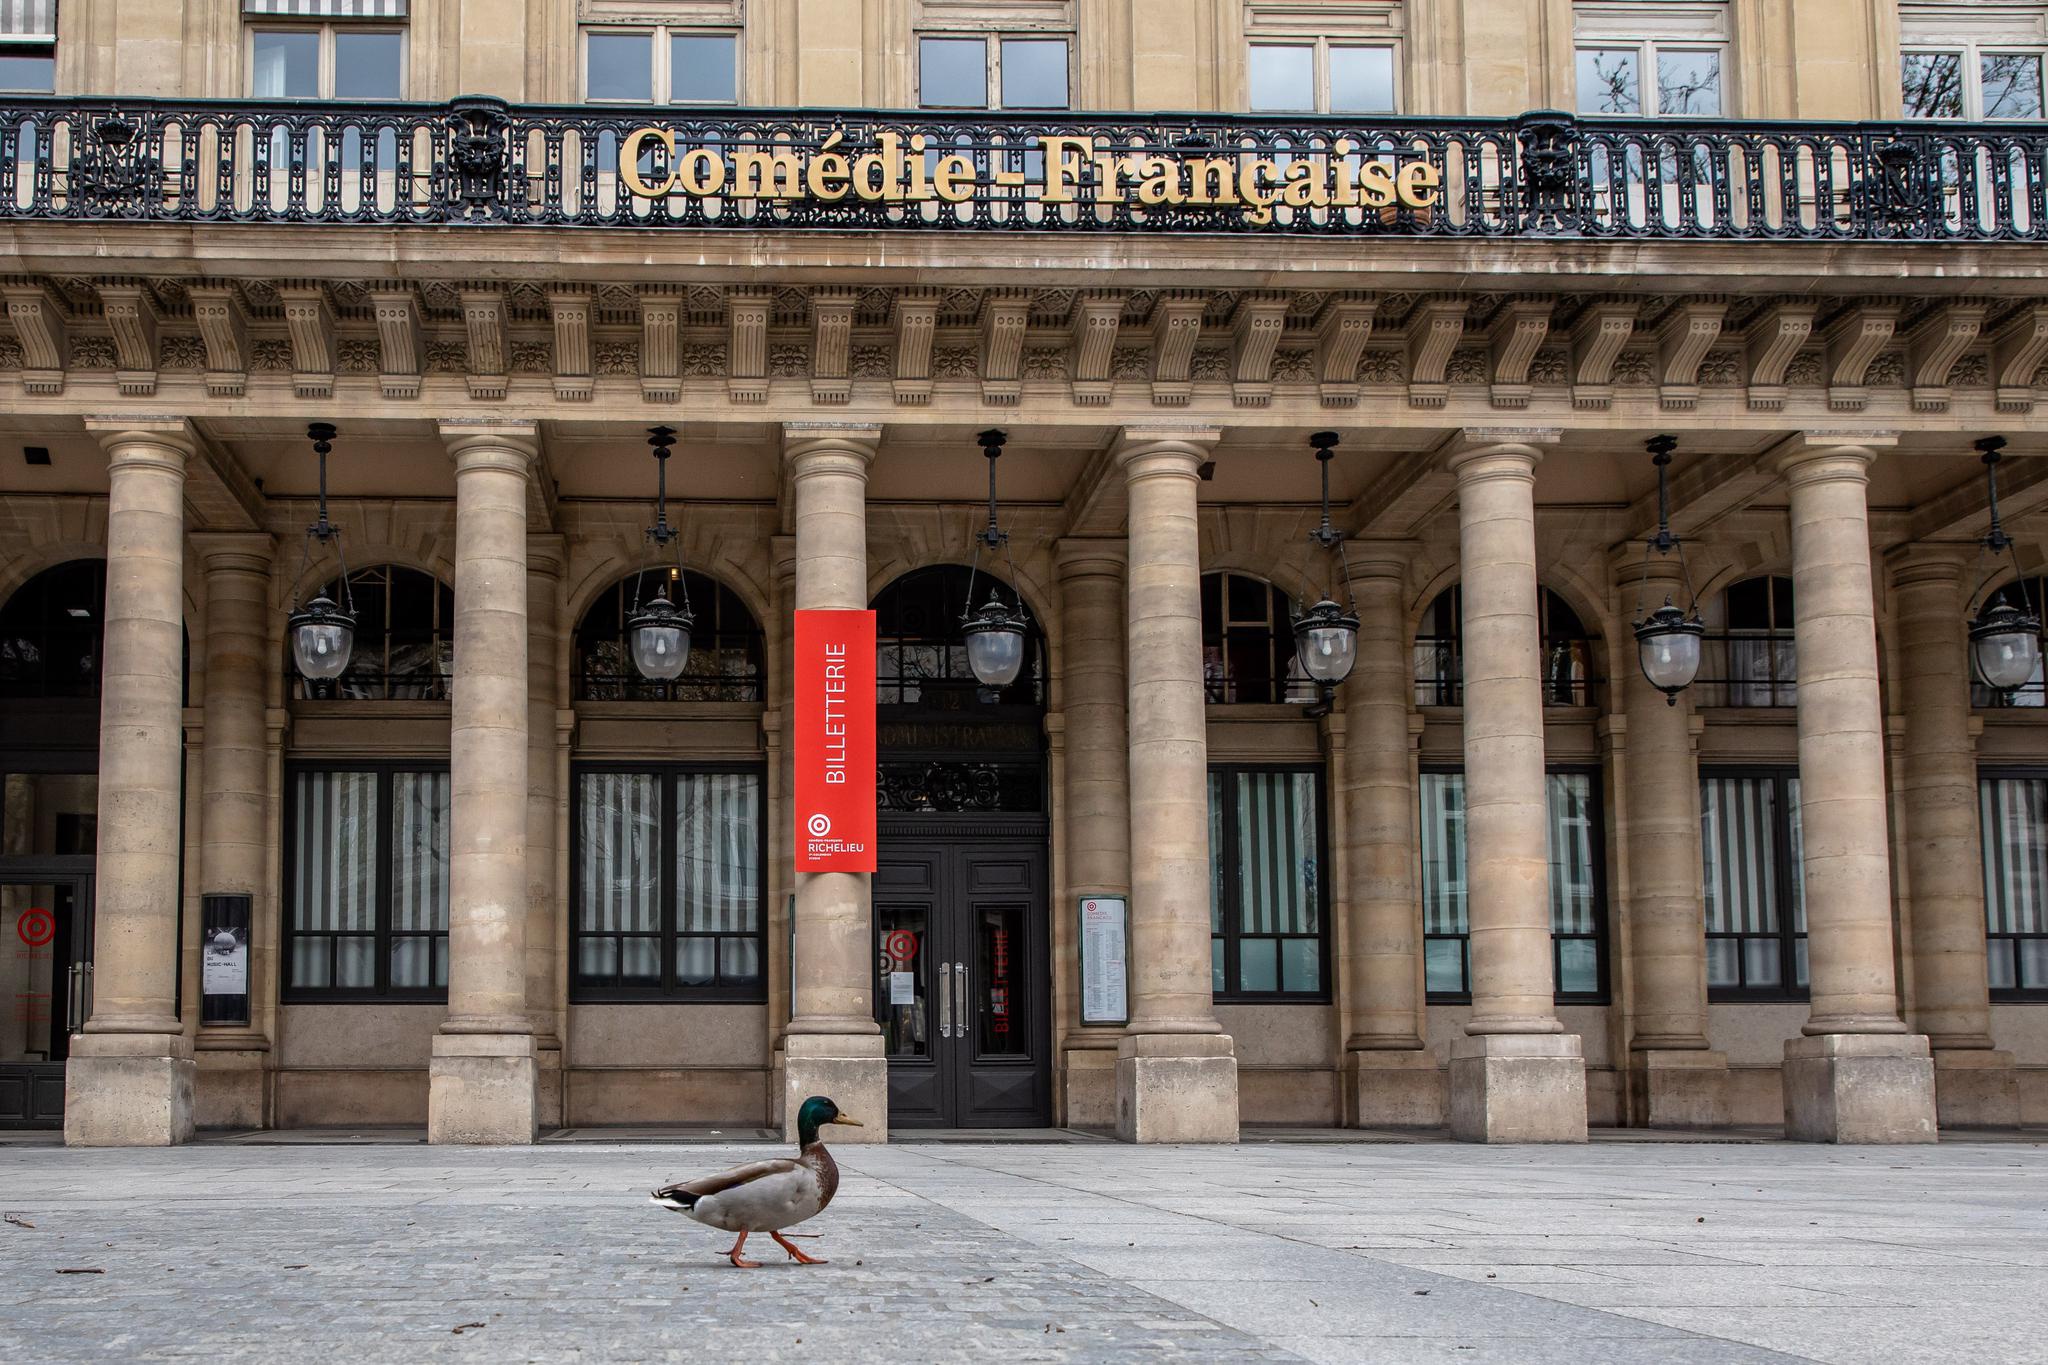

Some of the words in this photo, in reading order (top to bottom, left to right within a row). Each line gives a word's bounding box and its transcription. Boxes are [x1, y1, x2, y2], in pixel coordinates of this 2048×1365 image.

[620, 127, 977, 202] Comédie
[1038, 135, 1440, 225] Française
[825, 643, 846, 784] BILLETTERIE
[808, 843, 864, 852] RICHELIEU
[992, 930, 1009, 1032] BILLETTERIE
